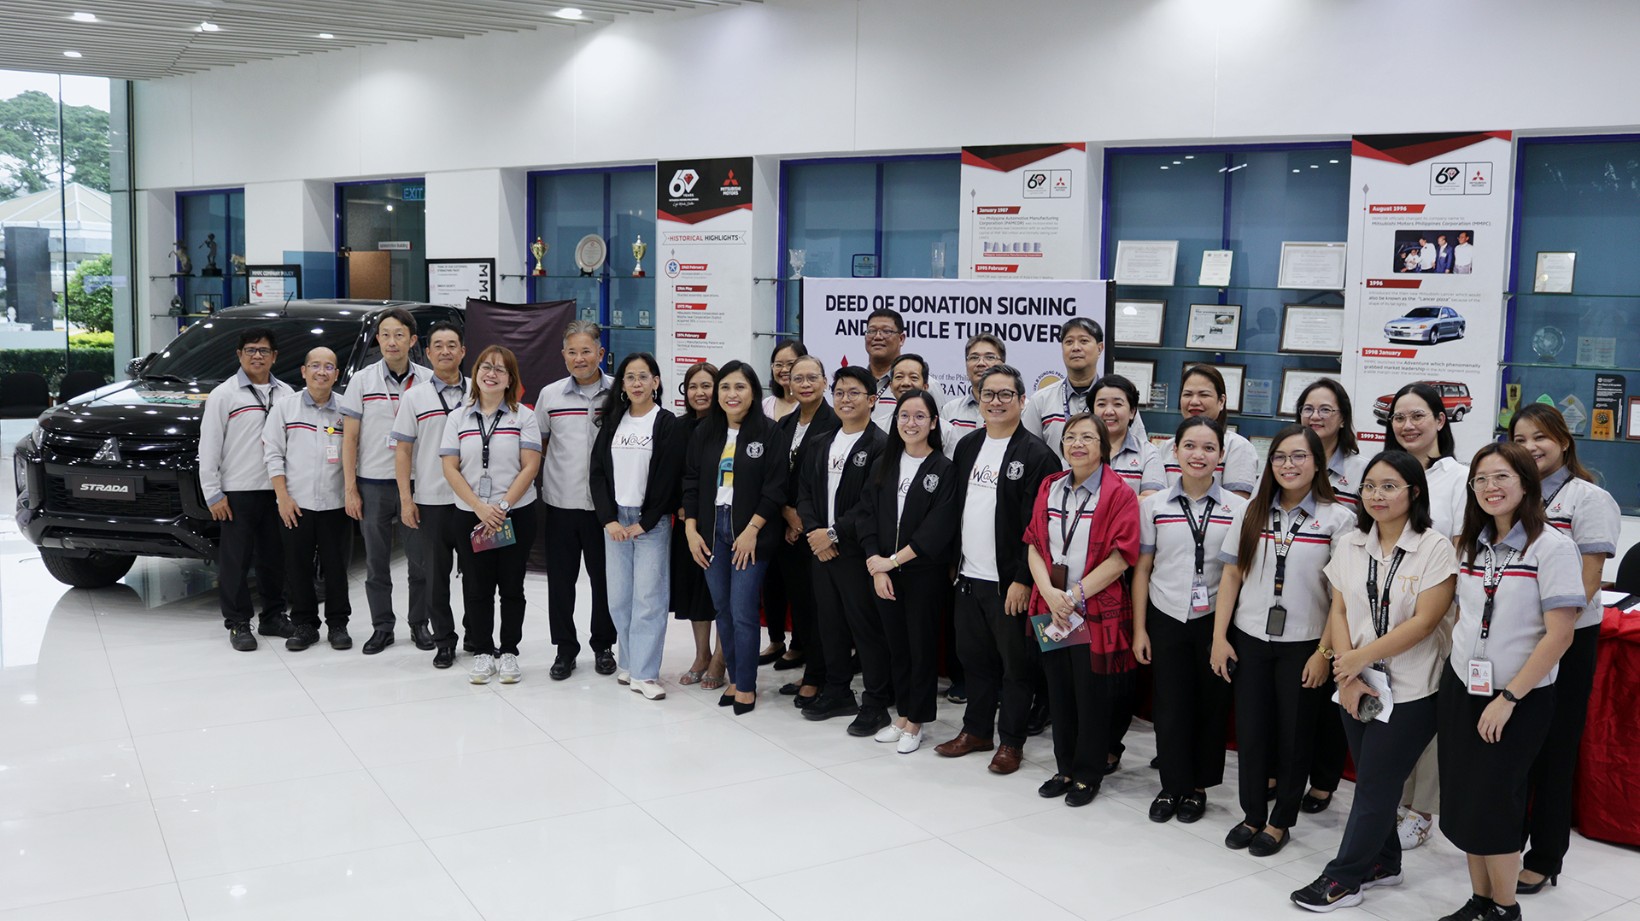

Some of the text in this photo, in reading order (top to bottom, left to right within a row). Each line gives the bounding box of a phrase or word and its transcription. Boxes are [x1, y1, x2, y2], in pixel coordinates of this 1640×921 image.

[404, 188, 423, 198] EXIT
[826, 295, 1076, 316] DEED OF DONATION SIGNING
[835, 319, 1062, 343] AND HICLE TURNOVER
[80, 484, 128, 492] STRADA
